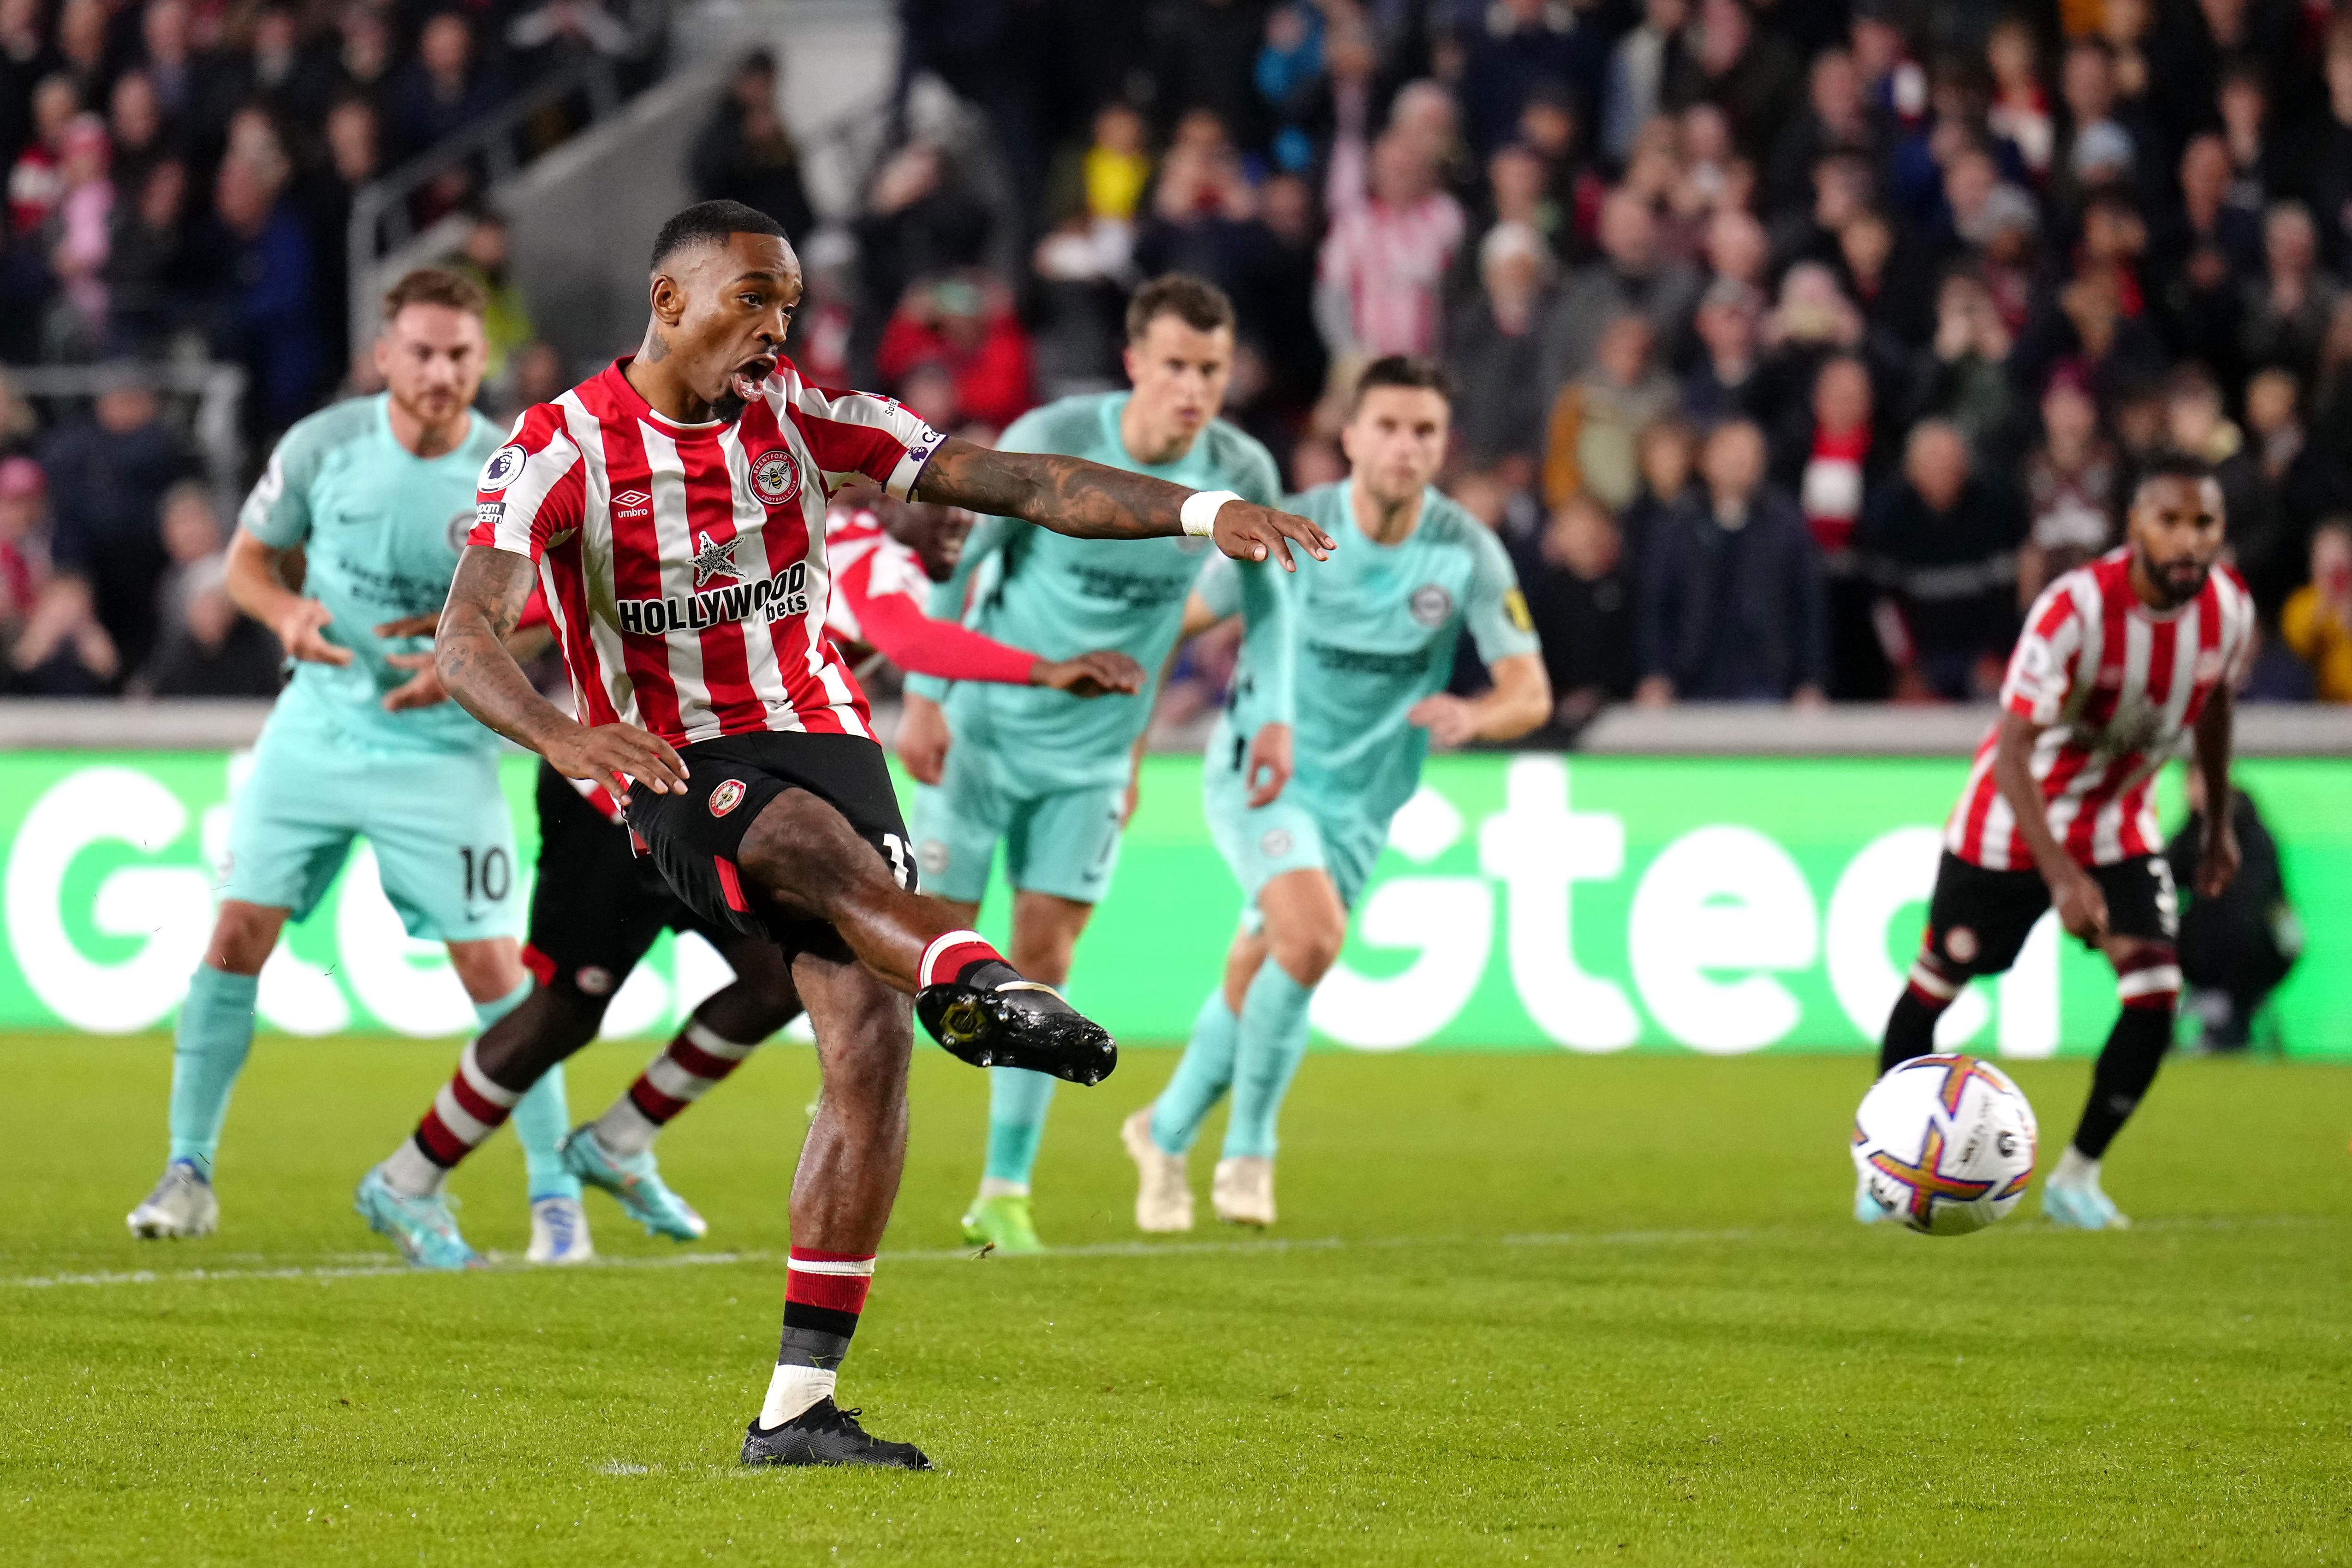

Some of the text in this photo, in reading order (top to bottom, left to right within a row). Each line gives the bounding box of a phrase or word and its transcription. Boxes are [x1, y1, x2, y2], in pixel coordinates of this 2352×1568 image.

[753, 453, 788, 474] BRENTFORD
[787, 480, 797, 494] CLUB
[617, 508, 648, 518] umbro
[618, 561, 807, 634] HOLLYWOOD
[765, 594, 808, 622] bets
[458, 845, 511, 903] 10
